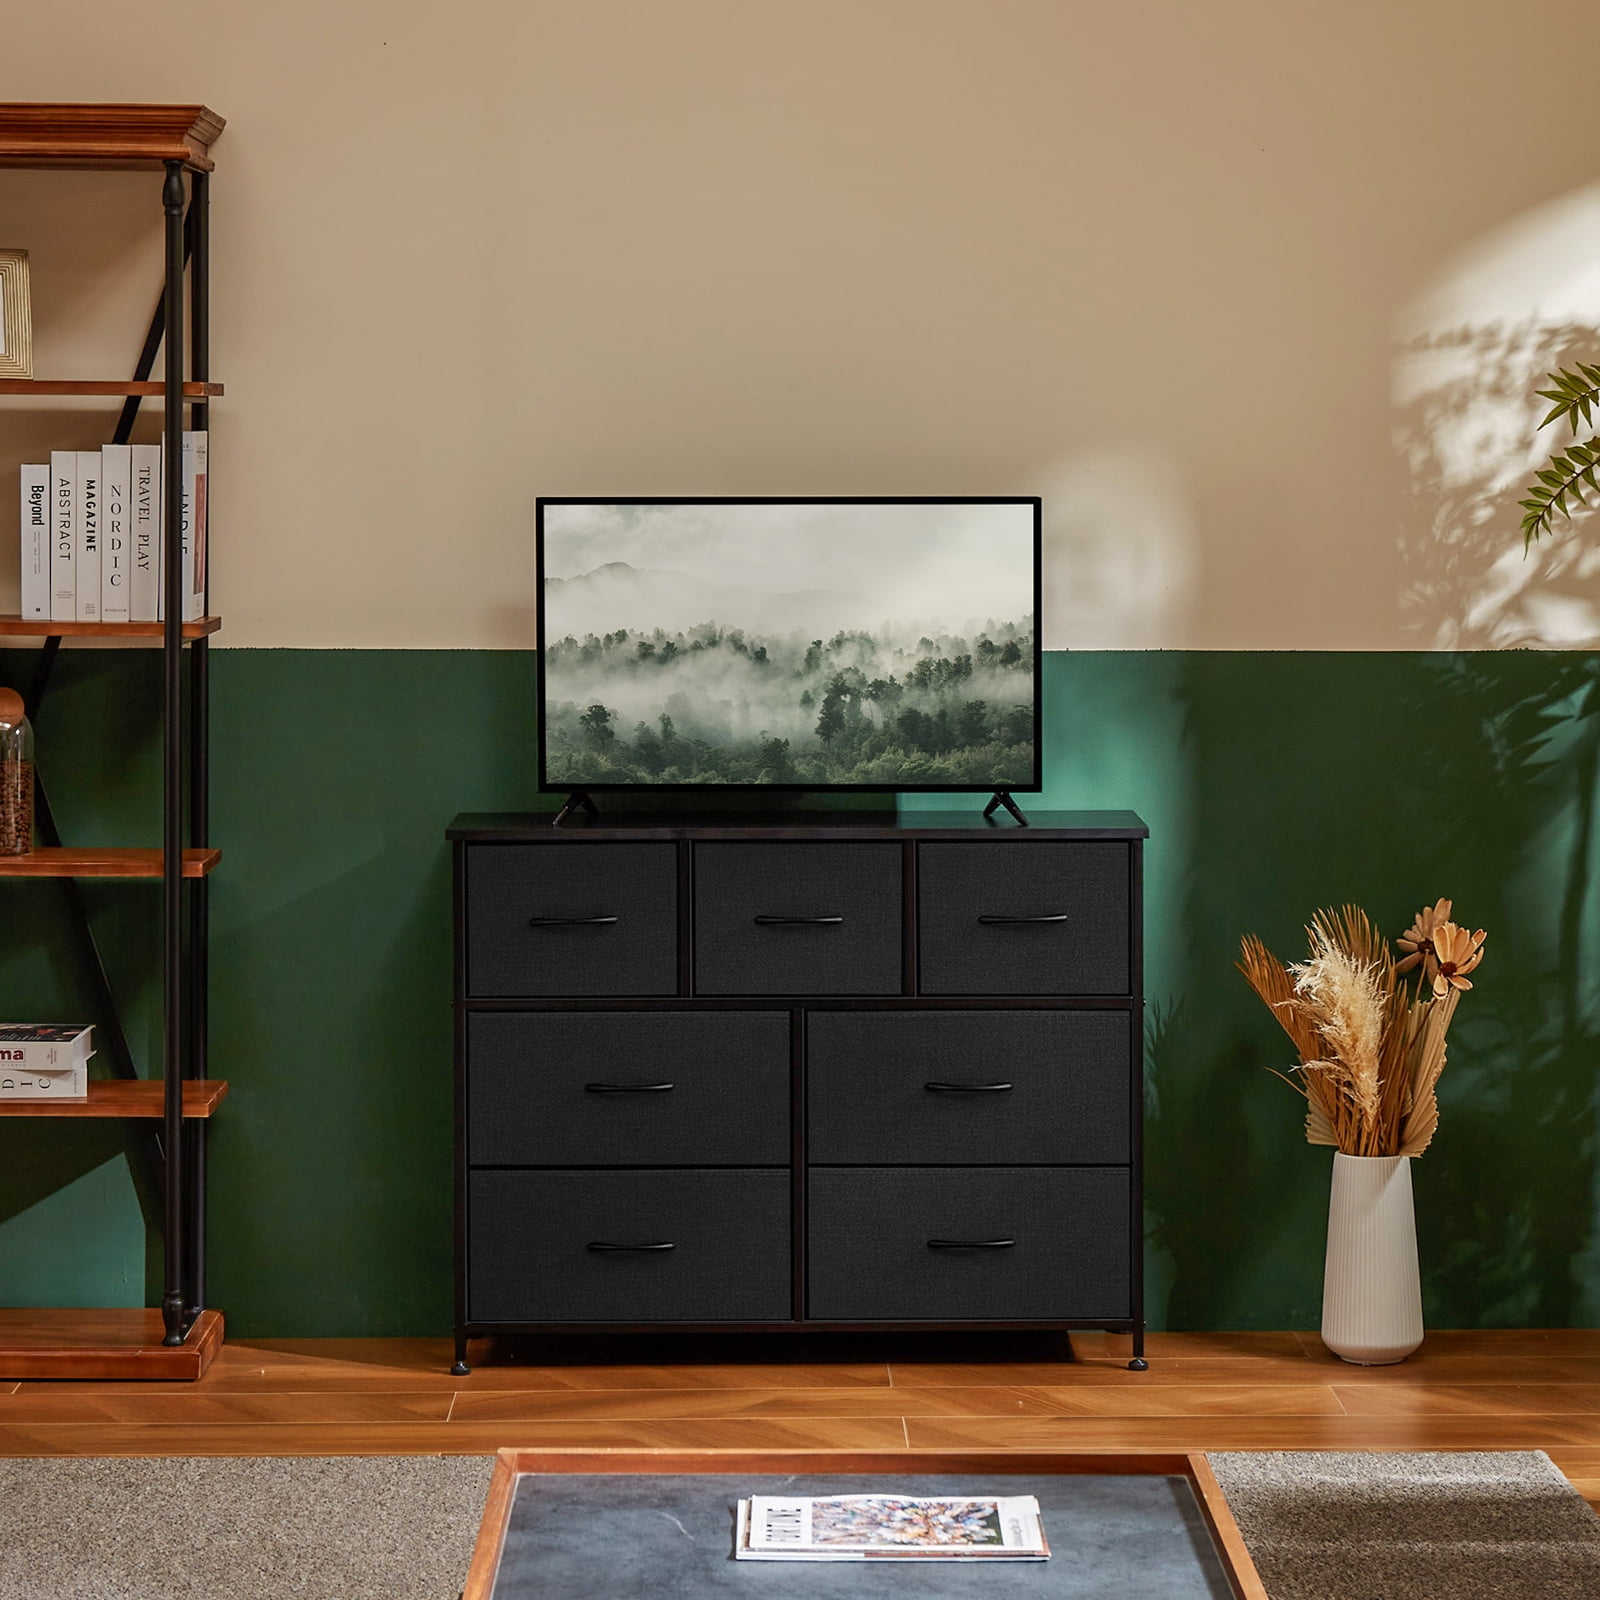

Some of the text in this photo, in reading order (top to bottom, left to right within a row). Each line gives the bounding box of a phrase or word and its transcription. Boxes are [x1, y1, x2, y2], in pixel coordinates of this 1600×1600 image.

[28, 485, 45, 526] Beyond
[59, 478, 71, 561] ABSTRACT
[85, 479, 97, 552] MAGAZINE
[110, 484, 122, 587] NORDIC
[138, 466, 151, 571] TRAVEL PLAY
